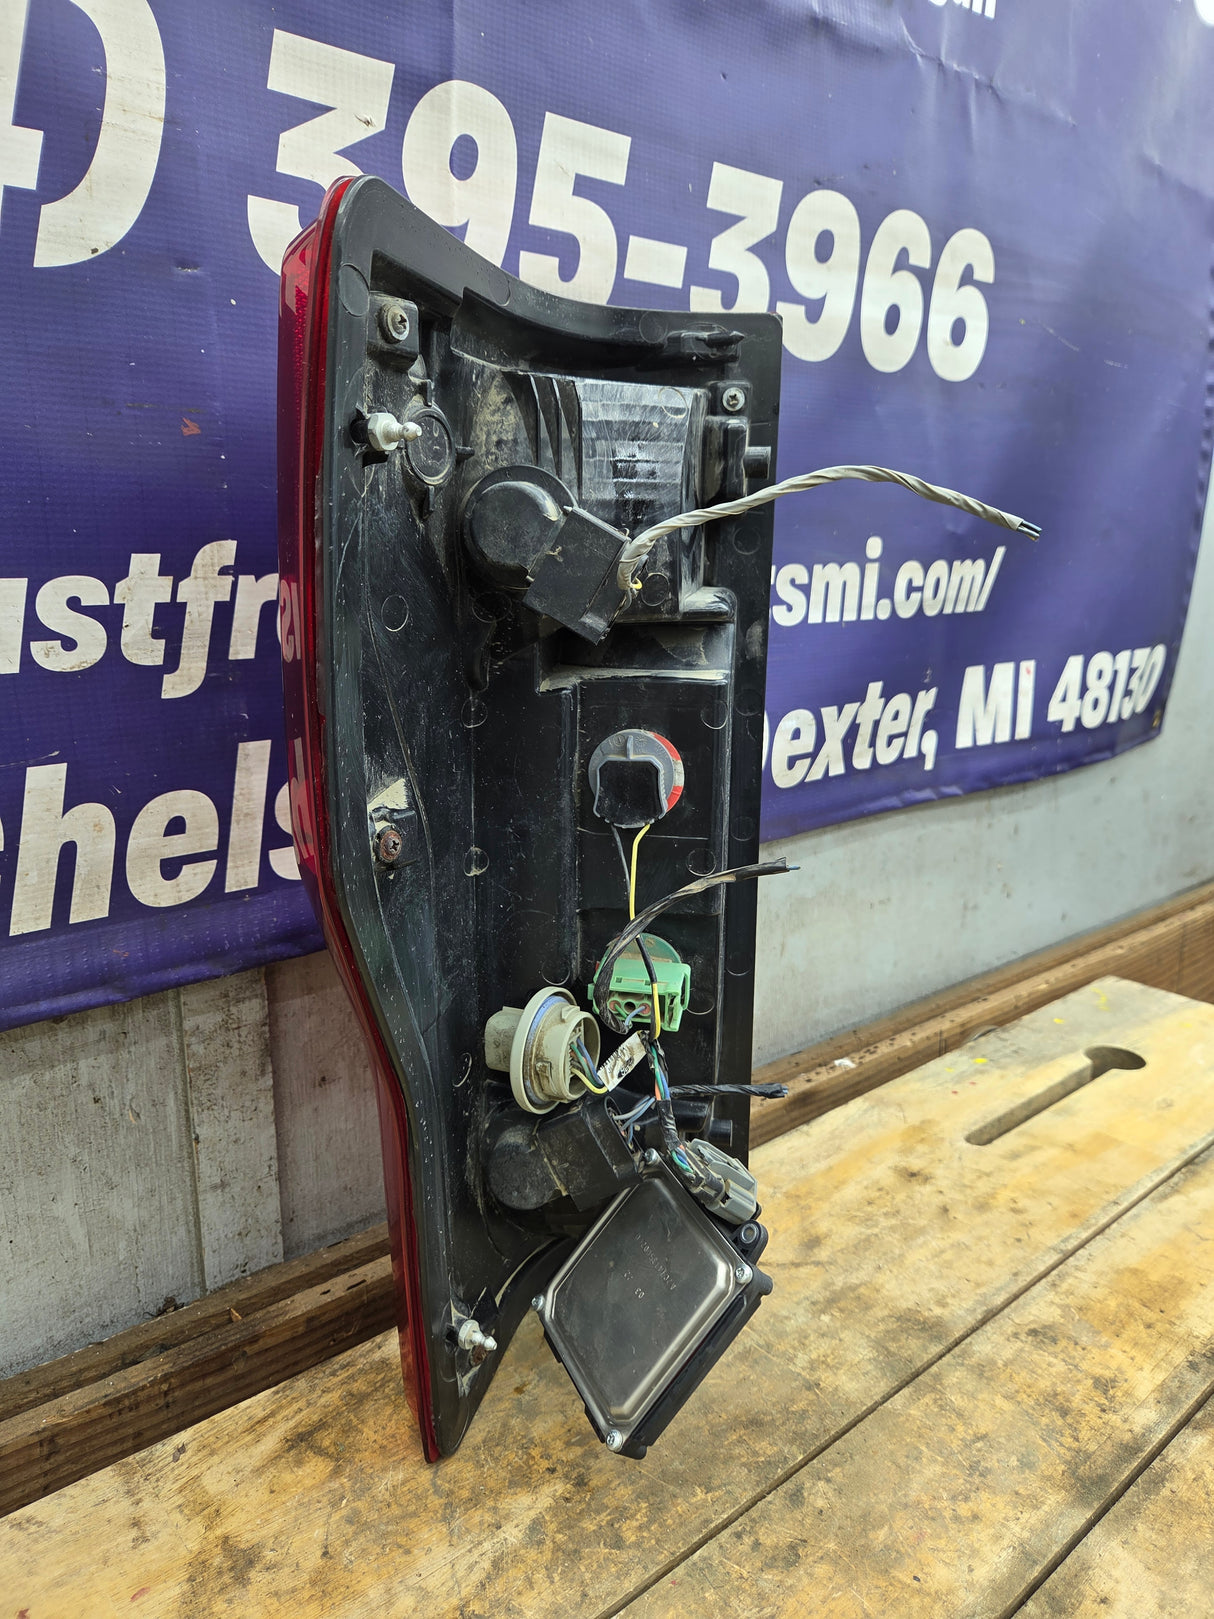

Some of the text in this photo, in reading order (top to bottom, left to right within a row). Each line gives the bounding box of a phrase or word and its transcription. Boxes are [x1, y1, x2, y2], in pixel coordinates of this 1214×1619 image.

[247, 28, 995, 383] 395-3966
[0, 536, 1007, 699] stfr smi.com/
[761, 680, 939, 789] exter,
[955, 659, 1037, 749] MI
[1046, 643, 1168, 734] 48130
